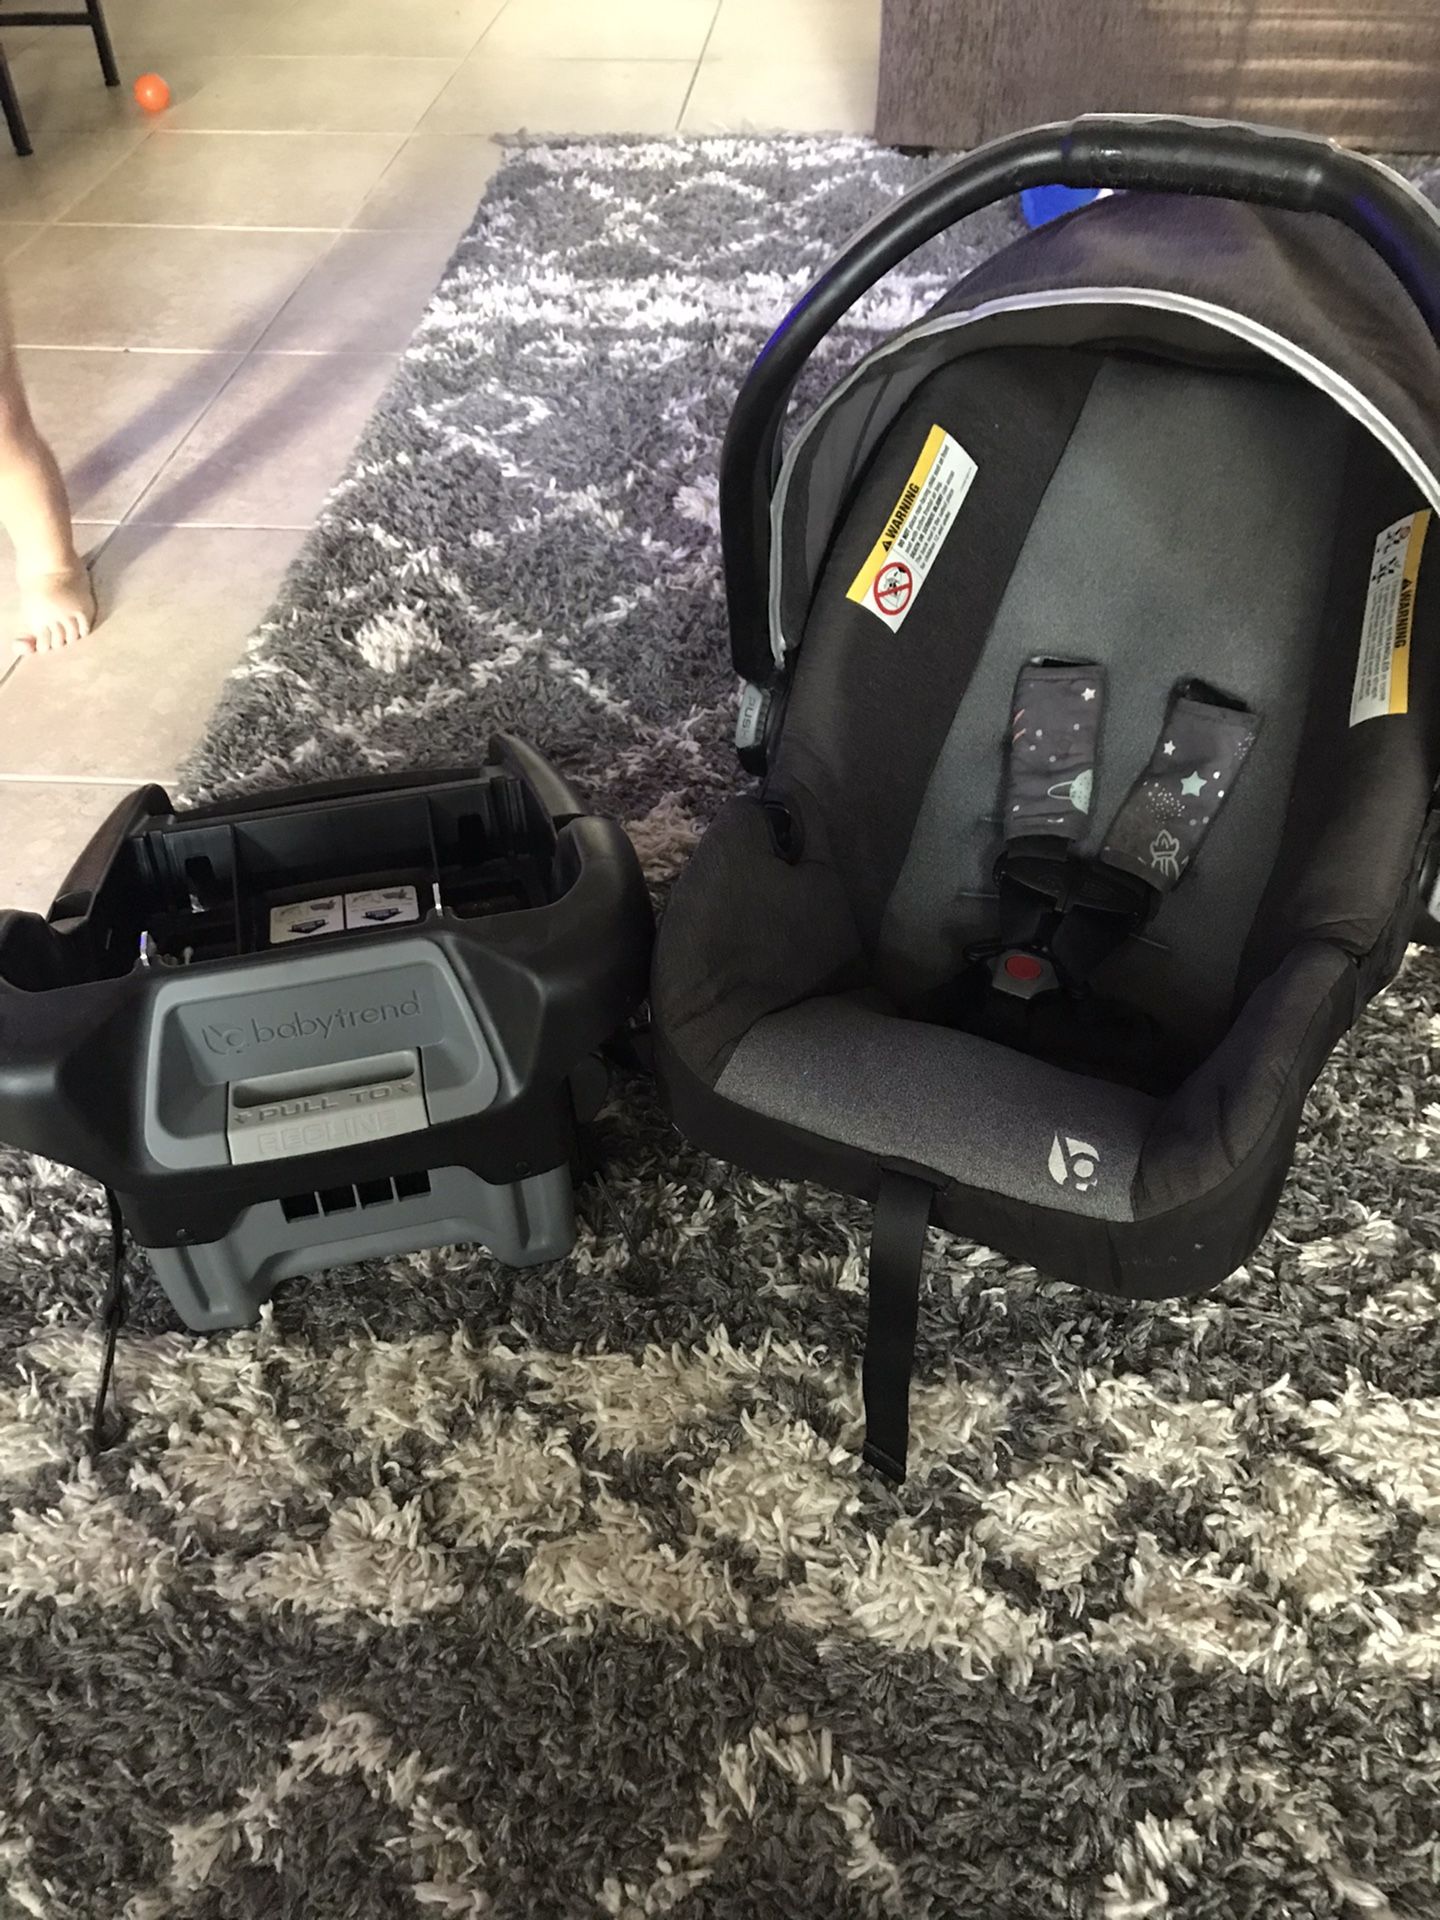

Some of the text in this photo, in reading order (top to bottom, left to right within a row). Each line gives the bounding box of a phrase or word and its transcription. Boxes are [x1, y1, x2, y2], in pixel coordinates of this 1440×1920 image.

[885, 482, 920, 543] WARNING
[1394, 591, 1412, 649] WARNING
[252, 990, 421, 1044] babytrend
[258, 1086, 393, 1122] PULL TO
